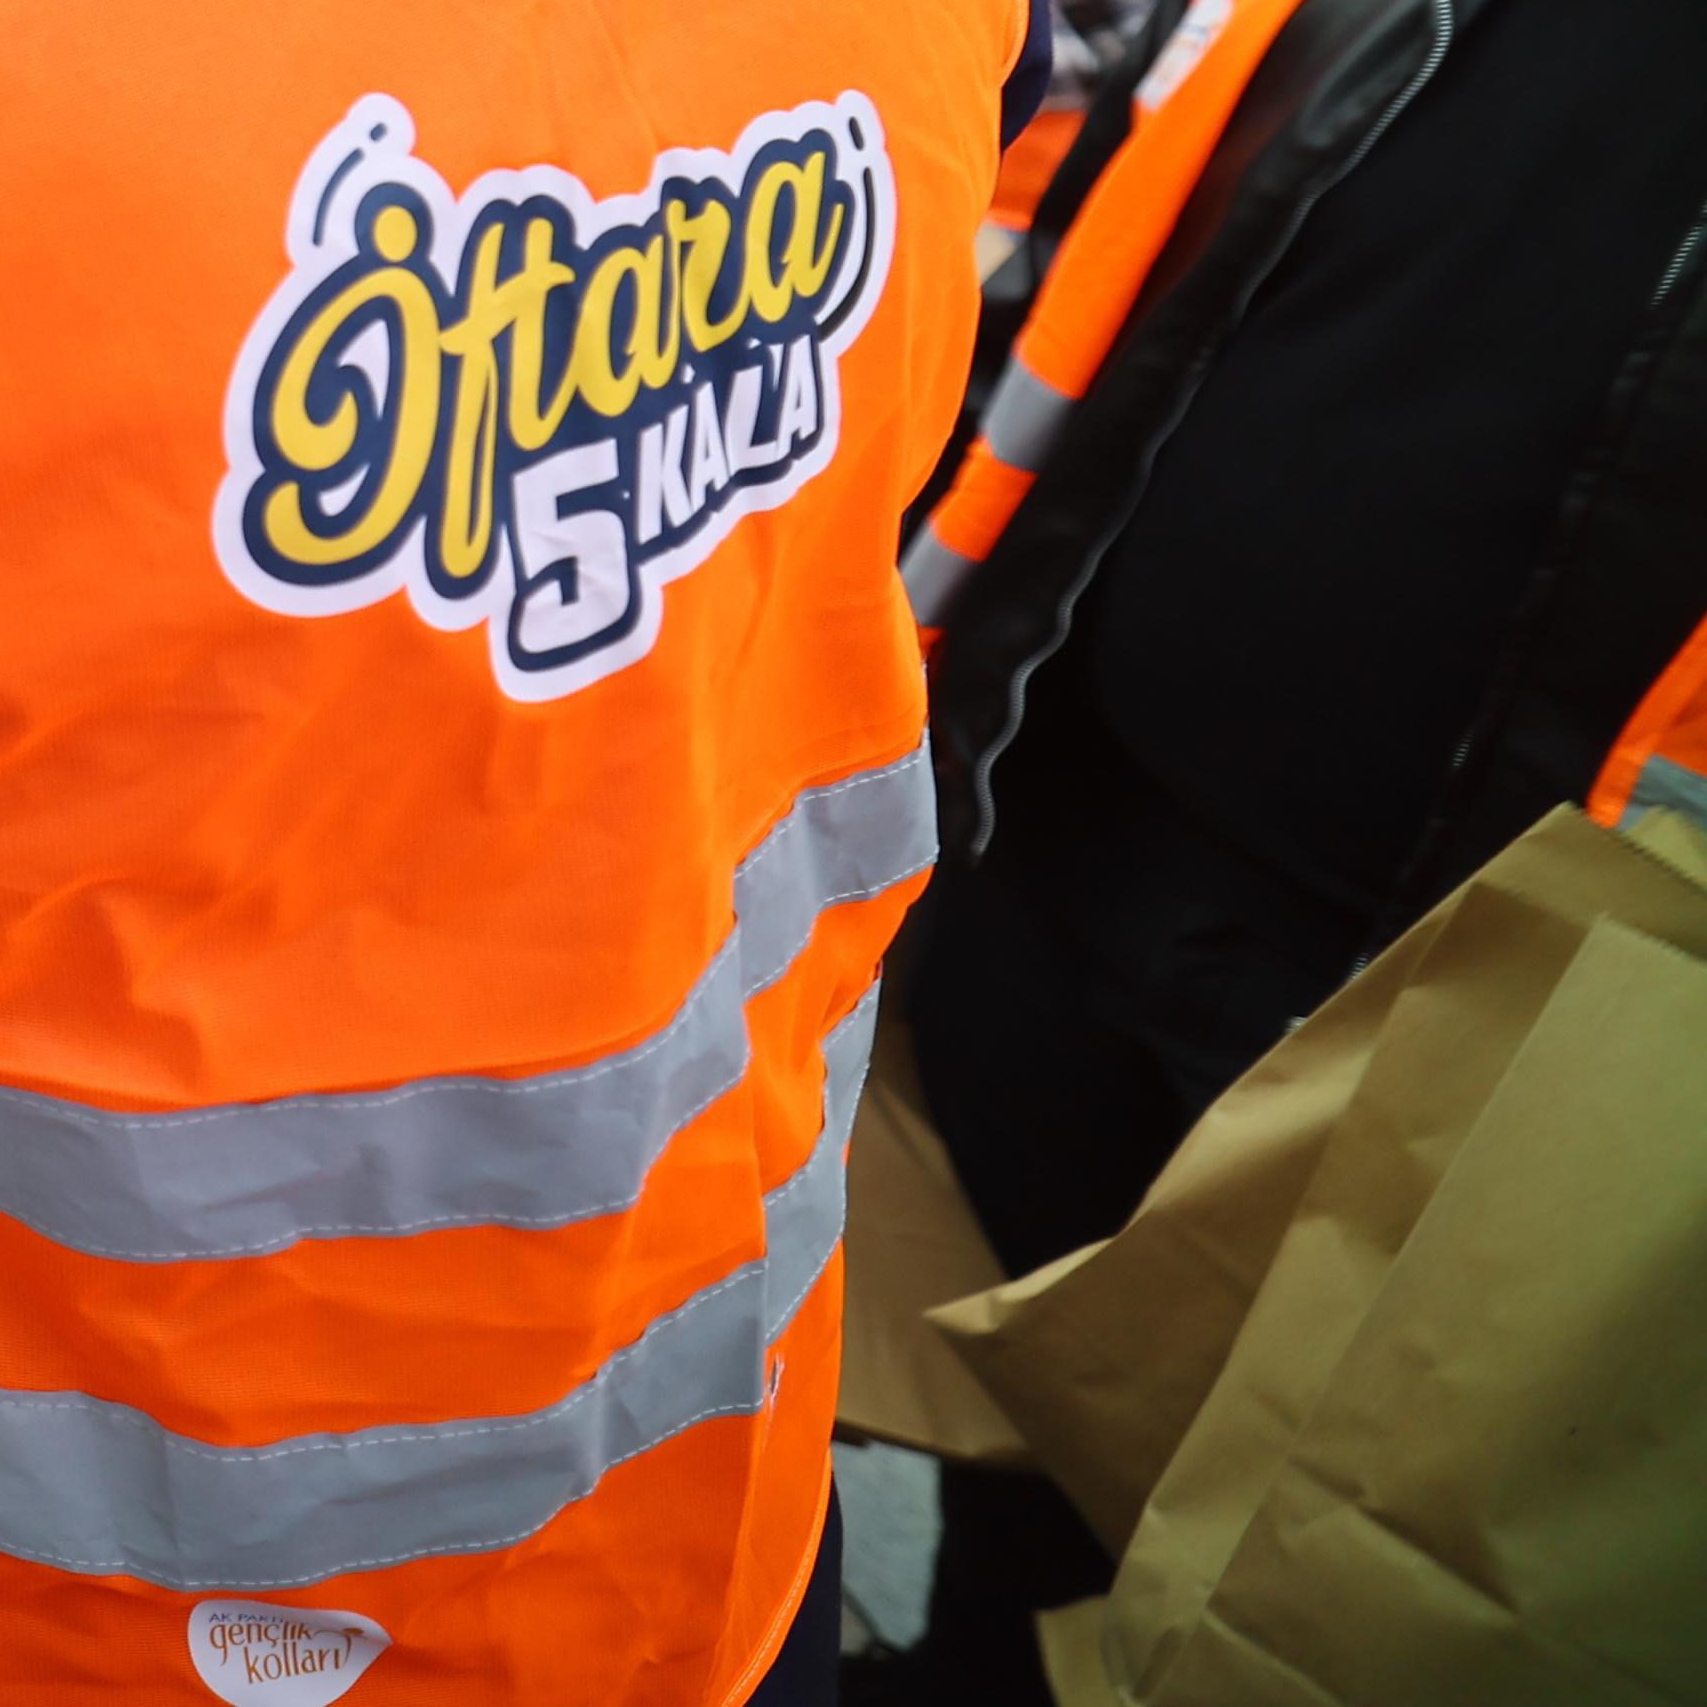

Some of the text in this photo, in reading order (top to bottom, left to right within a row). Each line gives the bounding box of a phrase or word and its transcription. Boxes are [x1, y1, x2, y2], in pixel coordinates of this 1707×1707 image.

[512, 334, 821, 655] 5 KALA
[243, 1640, 341, 1685] kolları
